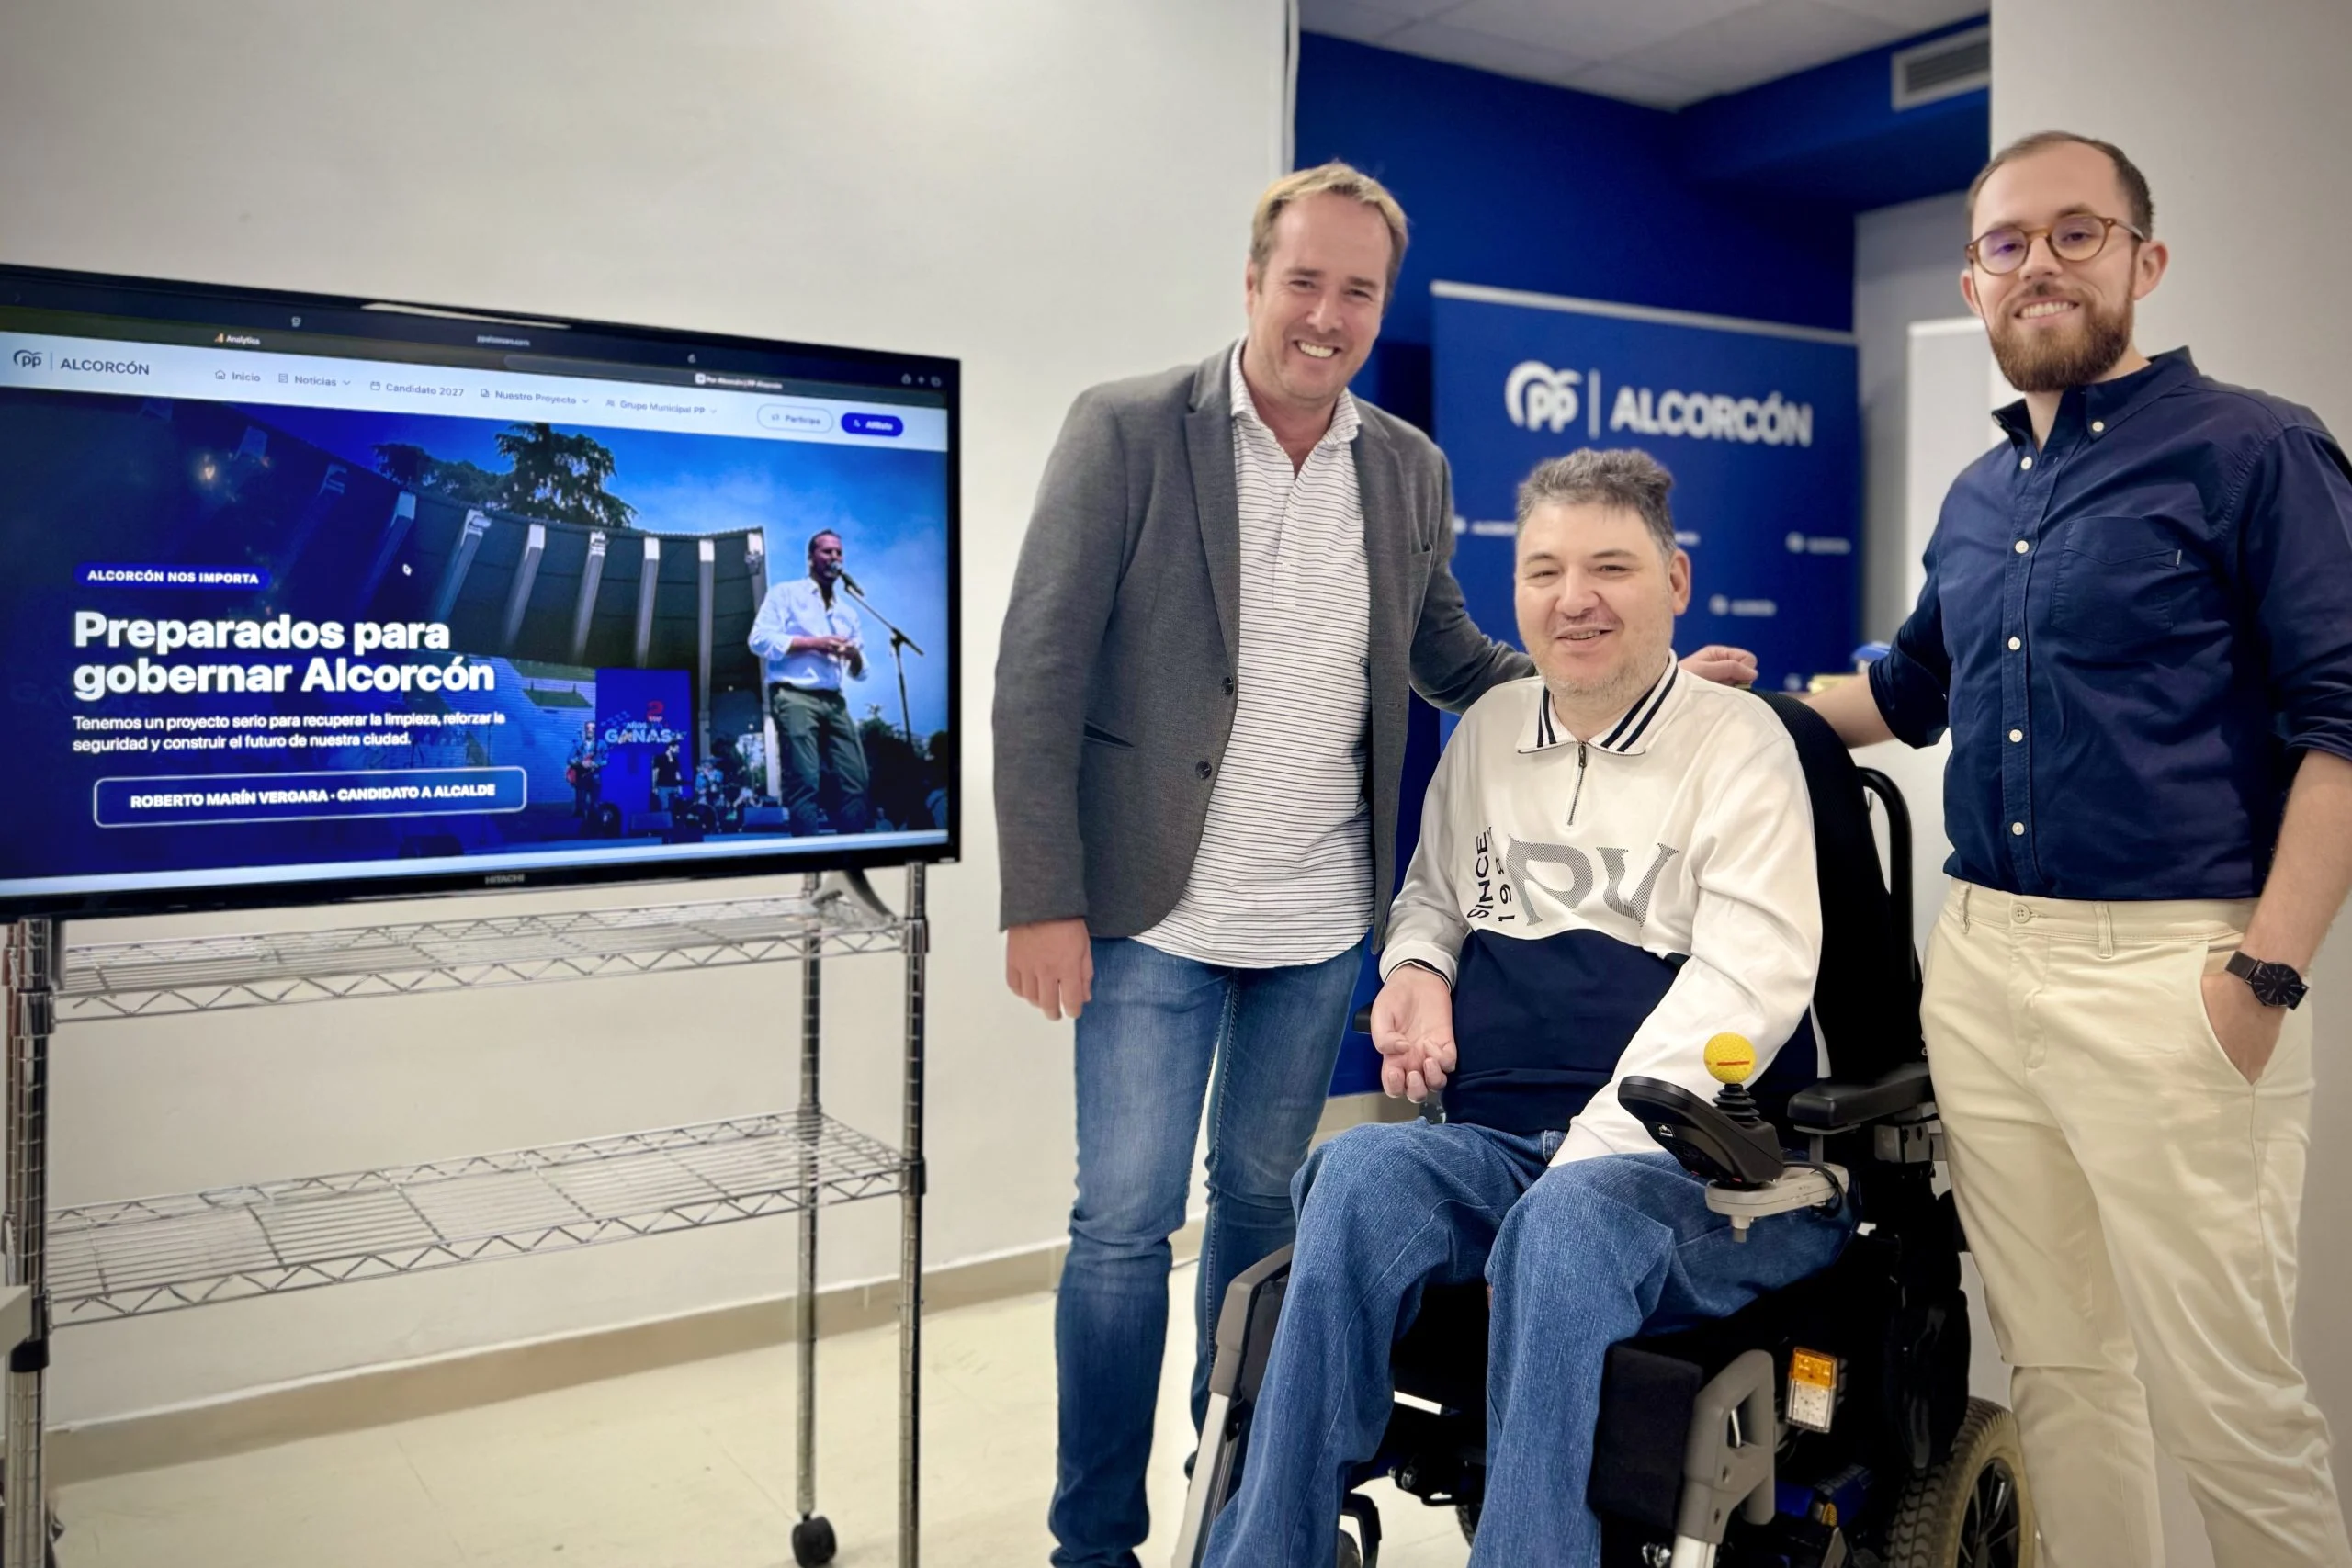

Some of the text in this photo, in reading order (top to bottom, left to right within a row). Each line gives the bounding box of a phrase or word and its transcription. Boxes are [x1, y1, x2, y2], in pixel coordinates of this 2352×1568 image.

[60, 358, 150, 376] ALCORCÓN
[232, 371, 261, 382] Inicio
[294, 375, 337, 387] Noticias
[386, 382, 464, 397] Candidato 2027
[494, 389, 577, 406] Nuestro Proyecto
[650, 401, 692, 414] Municipal
[1609, 384, 1814, 447] ALCORCÓN
[87, 569, 259, 585] ALCORCÓN NOS IMPORTA
[74, 611, 450, 657] Preparados para
[74, 655, 495, 702] gobernar Alcorcón
[73, 710, 505, 732] Tenemos un proyecto serio para recuperar la limpieza, reforzar la
[73, 731, 411, 754] seguridad y construir el futuro de nuestra ciudad.
[130, 793, 204, 808] ROBERTO
[206, 788, 256, 806] MARÍN
[258, 789, 328, 805] VERGARA
[336, 785, 419, 802] CANDIDATO
[421, 785, 432, 799] A
[434, 784, 496, 798] ALCALDE
[484, 874, 525, 885] HITACHI
[1466, 831, 1494, 919] SINCE
